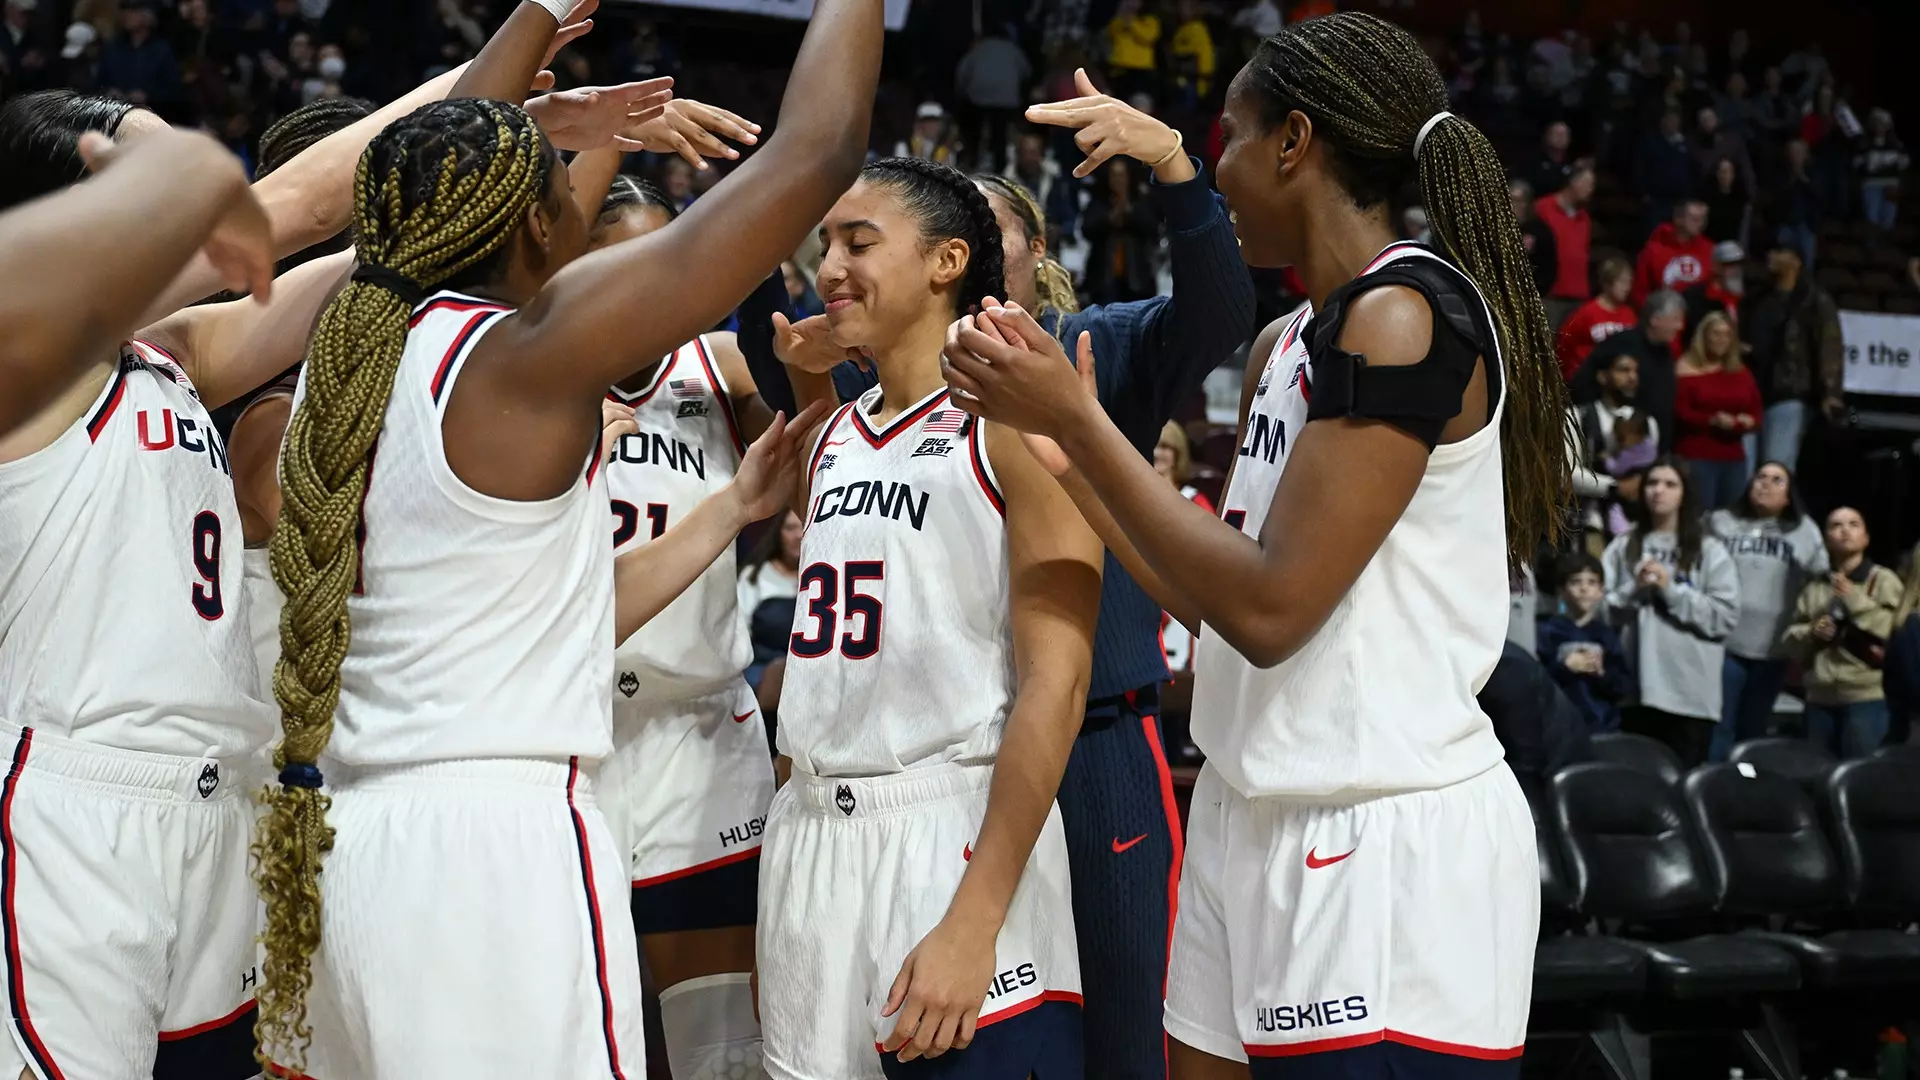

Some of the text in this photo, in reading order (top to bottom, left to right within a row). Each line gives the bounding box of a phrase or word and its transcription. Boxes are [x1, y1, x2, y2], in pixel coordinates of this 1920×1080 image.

[1868, 340, 1911, 368] the
[608, 432, 705, 481] ONN
[822, 453, 838, 462] THE
[915, 446, 954, 454] EAST
[921, 438, 950, 446] BIG
[803, 480, 930, 531] CONN
[192, 510, 224, 621] 9
[790, 561, 884, 660] 35
[719, 813, 768, 848] HUSK
[1256, 995, 1368, 1032] HUSKIES
